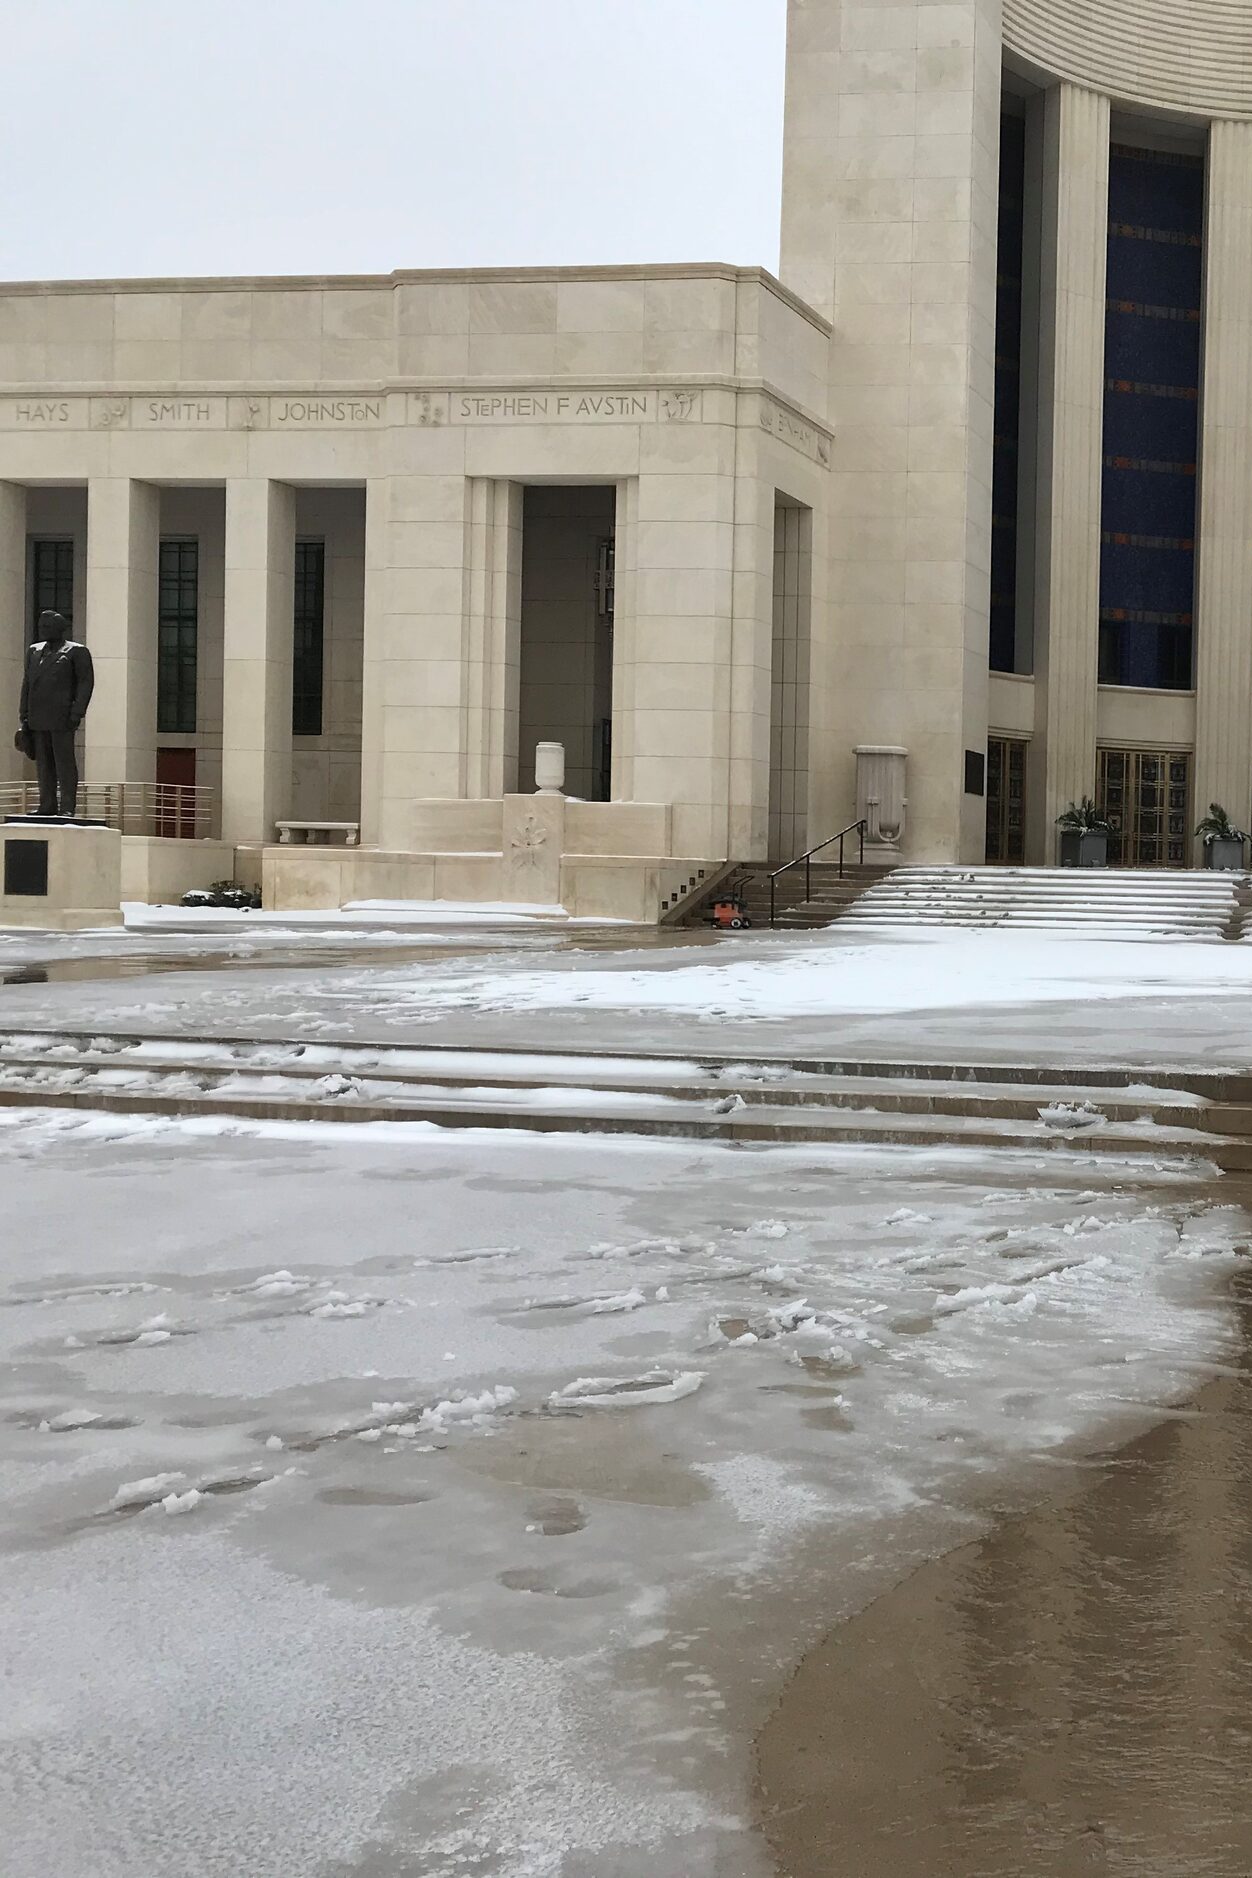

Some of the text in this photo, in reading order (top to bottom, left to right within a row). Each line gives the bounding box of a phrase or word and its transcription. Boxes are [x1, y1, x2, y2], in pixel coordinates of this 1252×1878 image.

[15, 403, 69, 422] HAYS
[148, 403, 210, 422] SMITH
[277, 402, 380, 421] JOHNSTON
[460, 397, 548, 417] STEPHEN
[556, 397, 570, 415] F
